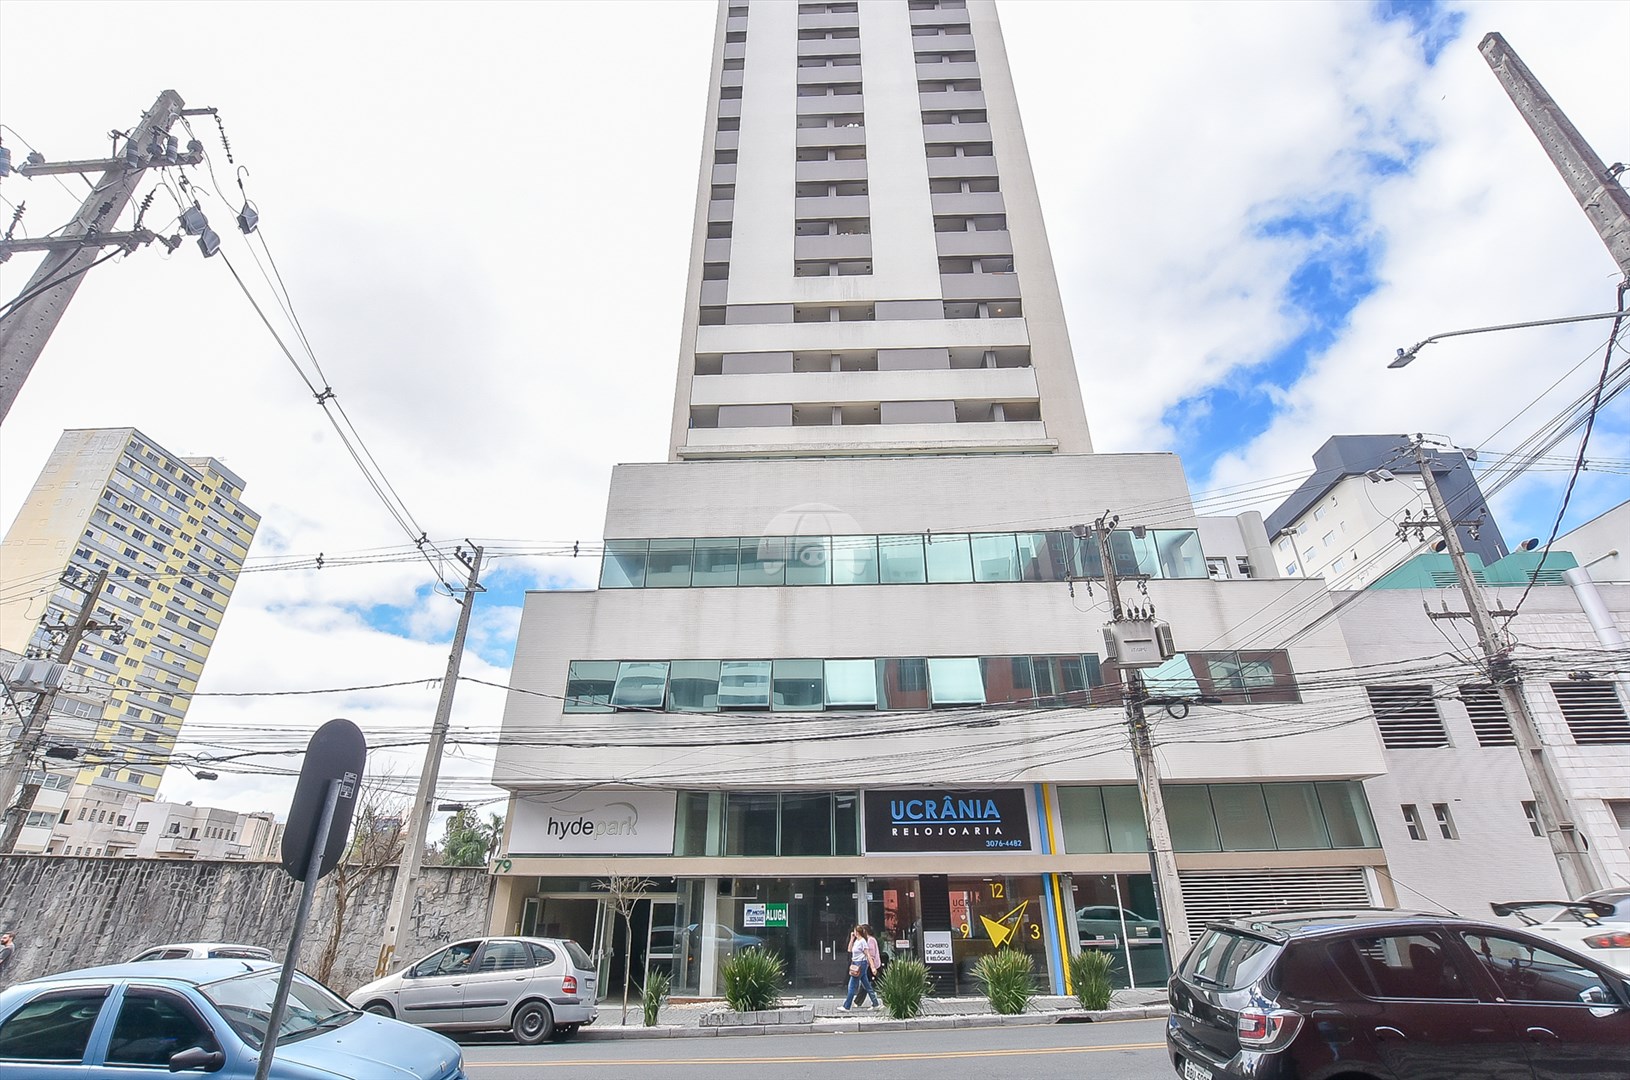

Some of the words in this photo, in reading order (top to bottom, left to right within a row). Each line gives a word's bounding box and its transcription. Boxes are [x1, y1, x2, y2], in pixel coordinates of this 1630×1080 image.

[890, 796, 1001, 820] UCRÂNIA
[891, 826, 1003, 837] RELOJOARIA
[985, 839, 1022, 848] 3076-4482
[494, 859, 512, 874] 79
[989, 883, 1004, 898] 12
[766, 910, 786, 920] ALUGA
[960, 923, 970, 939] 9
[1030, 923, 1041, 940] 3
